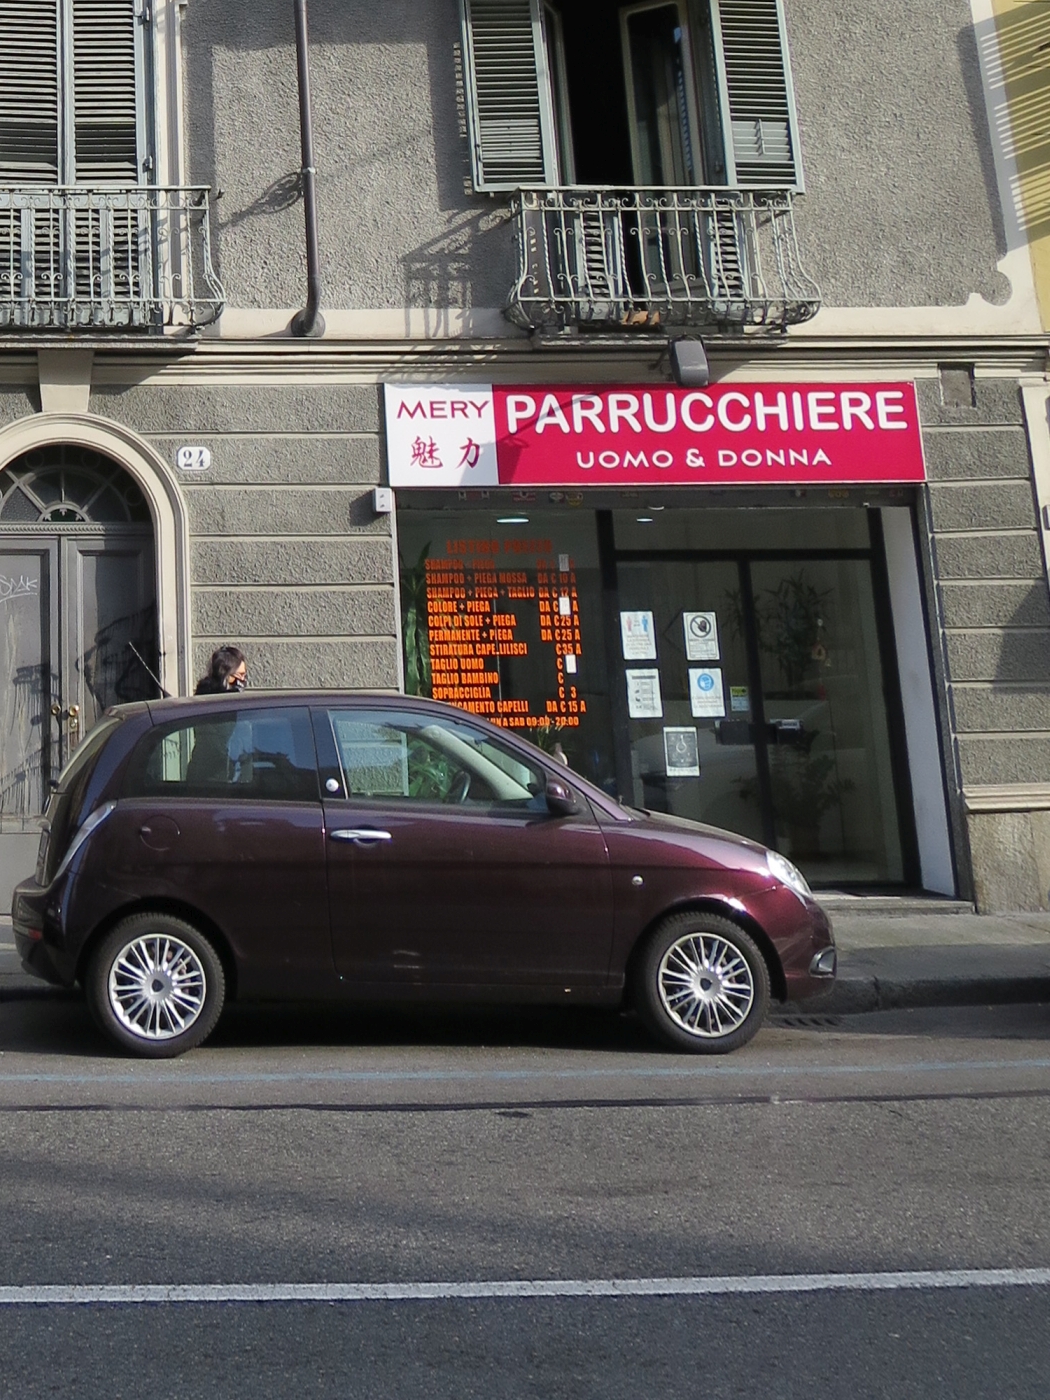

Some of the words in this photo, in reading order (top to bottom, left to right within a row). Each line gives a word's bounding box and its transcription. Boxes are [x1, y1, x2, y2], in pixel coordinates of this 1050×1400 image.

[396, 400, 490, 419] MERY
[506, 391, 908, 435] PARRUCCHIERE
[410, 435, 481, 469] 魅力
[183, 449, 205, 468] 24
[576, 450, 674, 469] UOMO
[685, 448, 706, 468] &
[718, 449, 832, 467] DONNA
[426, 573, 465, 584] SHAMPOO
[426, 587, 466, 598] SHAMPOO
[475, 587, 499, 598] PIEGA
[507, 587, 535, 598] TAGLIO
[427, 601, 458, 612] COLORE
[466, 601, 491, 612] PIEGA
[539, 601, 551, 612] DA
[464, 615, 484, 627] SOLE
[492, 615, 517, 627] PIEGA
[540, 615, 552, 627] DA
[561, 615, 572, 627] 25
[429, 629, 481, 641] PERMANENTE
[489, 629, 514, 641] PIEGA
[541, 629, 553, 641] DA
[562, 629, 573, 641] 25
[430, 643, 474, 656] STIRATURA
[431, 658, 459, 670] TAGLIO
[460, 658, 484, 670] UOMO
[431, 672, 459, 684] TAGLIO
[461, 672, 499, 684] BAMBINO
[432, 687, 492, 699] SOPRACCIGLIA
[570, 687, 577, 699] 3
[497, 701, 529, 713] CAPELLI
[546, 701, 558, 713] DA
[568, 701, 578, 713] 15
[509, 717, 525, 726] SAB
